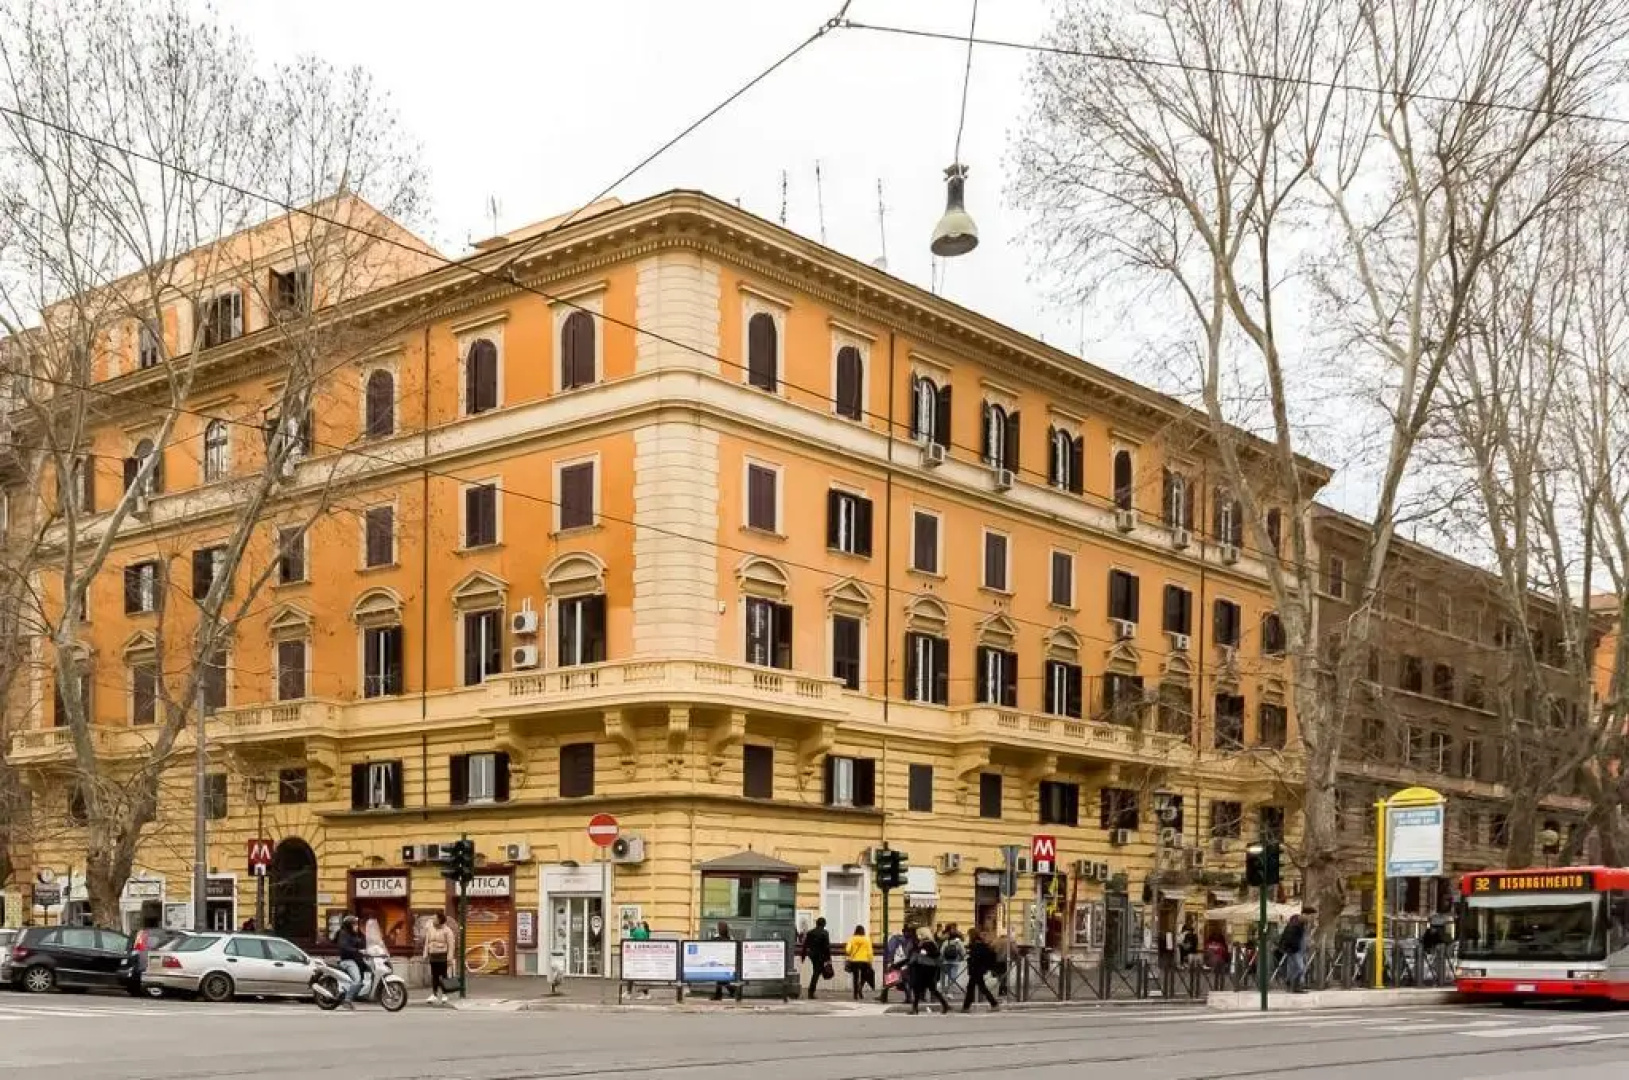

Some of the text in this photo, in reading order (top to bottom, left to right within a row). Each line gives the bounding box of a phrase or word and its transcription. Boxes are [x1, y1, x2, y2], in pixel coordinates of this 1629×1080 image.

[251, 838, 271, 860] M
[1034, 839, 1053, 856] M
[360, 879, 402, 890] OTTICA
[472, 877, 506, 888] TTICA
[1475, 877, 1490, 891] 32
